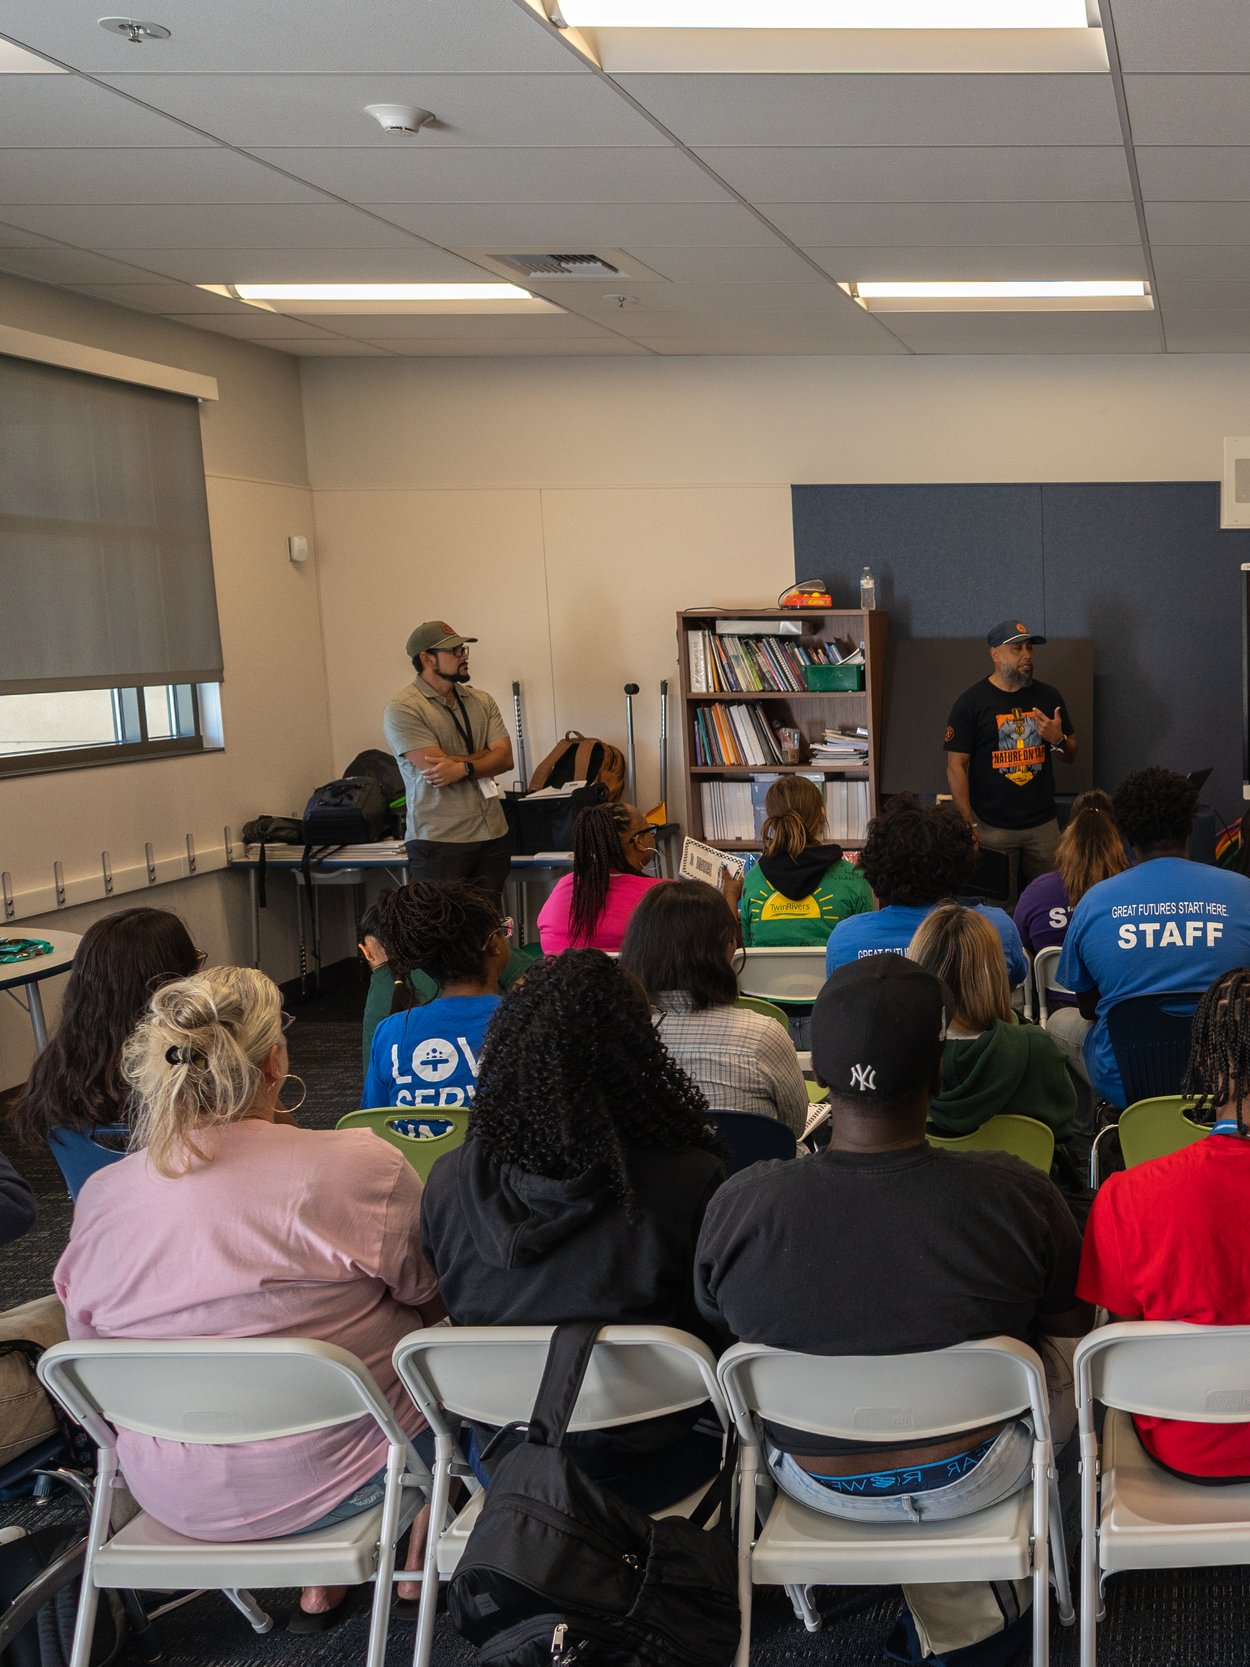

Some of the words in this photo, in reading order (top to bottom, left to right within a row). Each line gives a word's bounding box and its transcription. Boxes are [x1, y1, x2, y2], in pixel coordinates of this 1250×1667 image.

[994, 751, 1022, 763] NATURE
[1024, 749, 1034, 760] ON
[770, 902, 810, 911] TwinRivers
[1111, 904, 1137, 918] GREAT
[1138, 902, 1177, 916] FUTURES
[1178, 901, 1204, 915] START
[1205, 902, 1230, 917] HERE.
[1117, 921, 1224, 949] STAFF
[850, 1063, 877, 1091] NY
